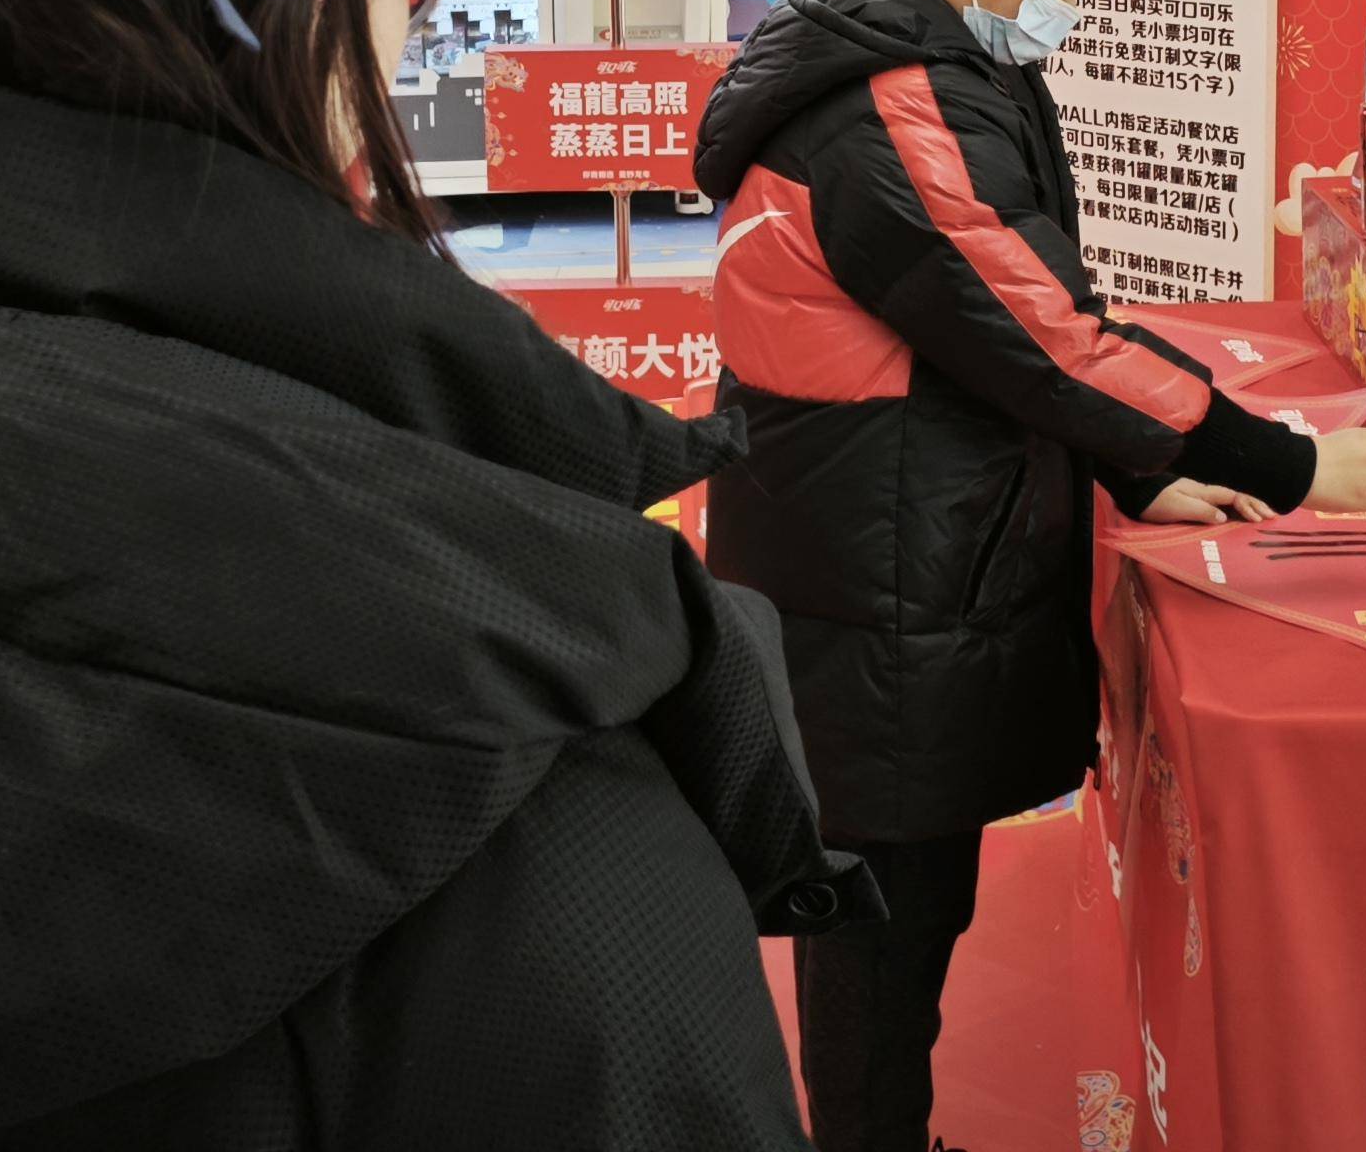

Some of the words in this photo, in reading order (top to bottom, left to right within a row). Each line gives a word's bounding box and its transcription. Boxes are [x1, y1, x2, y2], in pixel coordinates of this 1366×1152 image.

[549, 80, 689, 117] 福龍高照
[549, 122, 689, 158] 蒸蒸日上
[1076, 198, 1240, 242] 看餐饮店内活动指引）
